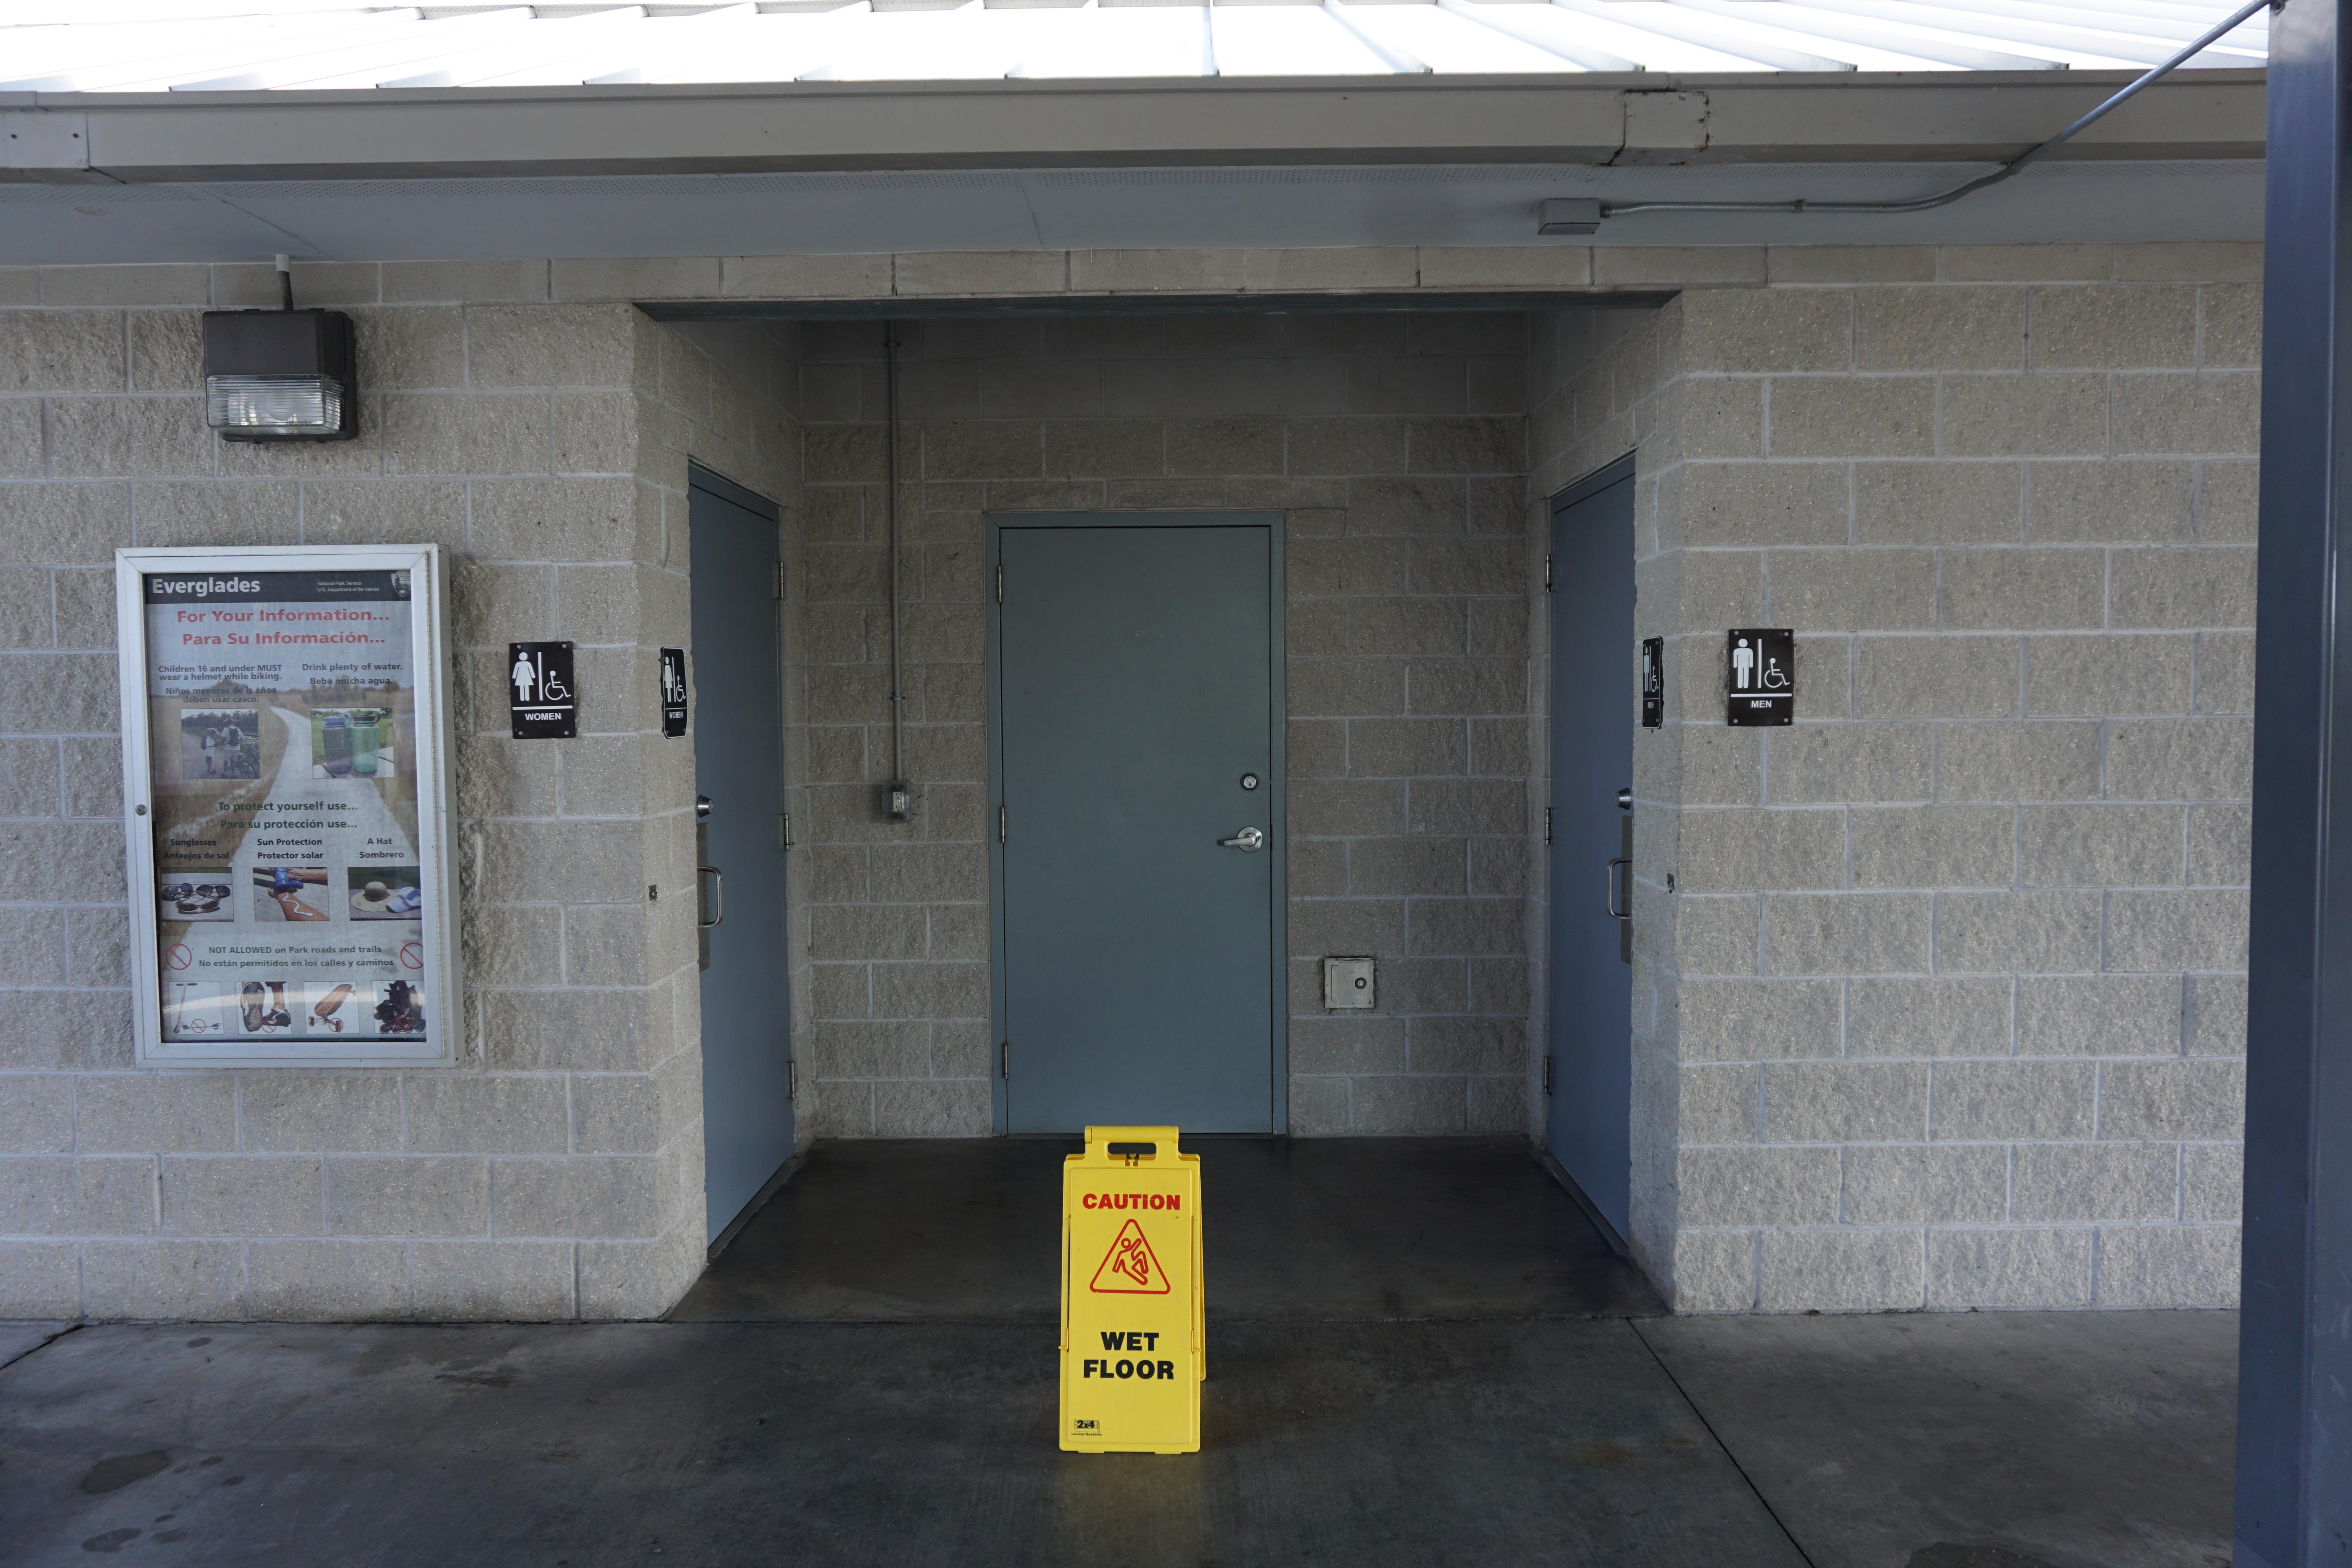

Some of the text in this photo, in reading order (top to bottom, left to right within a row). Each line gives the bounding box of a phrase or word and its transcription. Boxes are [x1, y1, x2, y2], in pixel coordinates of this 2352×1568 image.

[152, 576, 261, 597] Everglades
[177, 608, 389, 622] For Your Information...
[183, 631, 385, 645] Para Su Información...
[329, 663, 359, 672] plenty
[251, 672, 282, 681] biking.
[524, 712, 562, 721] WOMEN
[669, 711, 683, 719] WOMEN
[218, 802, 230, 811] To
[233, 802, 274, 813] protect
[277, 801, 324, 813] yourself
[221, 820, 245, 828] Para
[263, 819, 323, 830] protección
[170, 838, 216, 847] Sunglasses
[164, 852, 201, 860] Anteojos
[240, 959, 289, 968] permitidos
[1082, 1193, 1181, 1210] CAUTION
[1100, 1331, 1160, 1352] WET
[1083, 1359, 1174, 1380] FLOOR
[1077, 1420, 1095, 1428] 2x4
